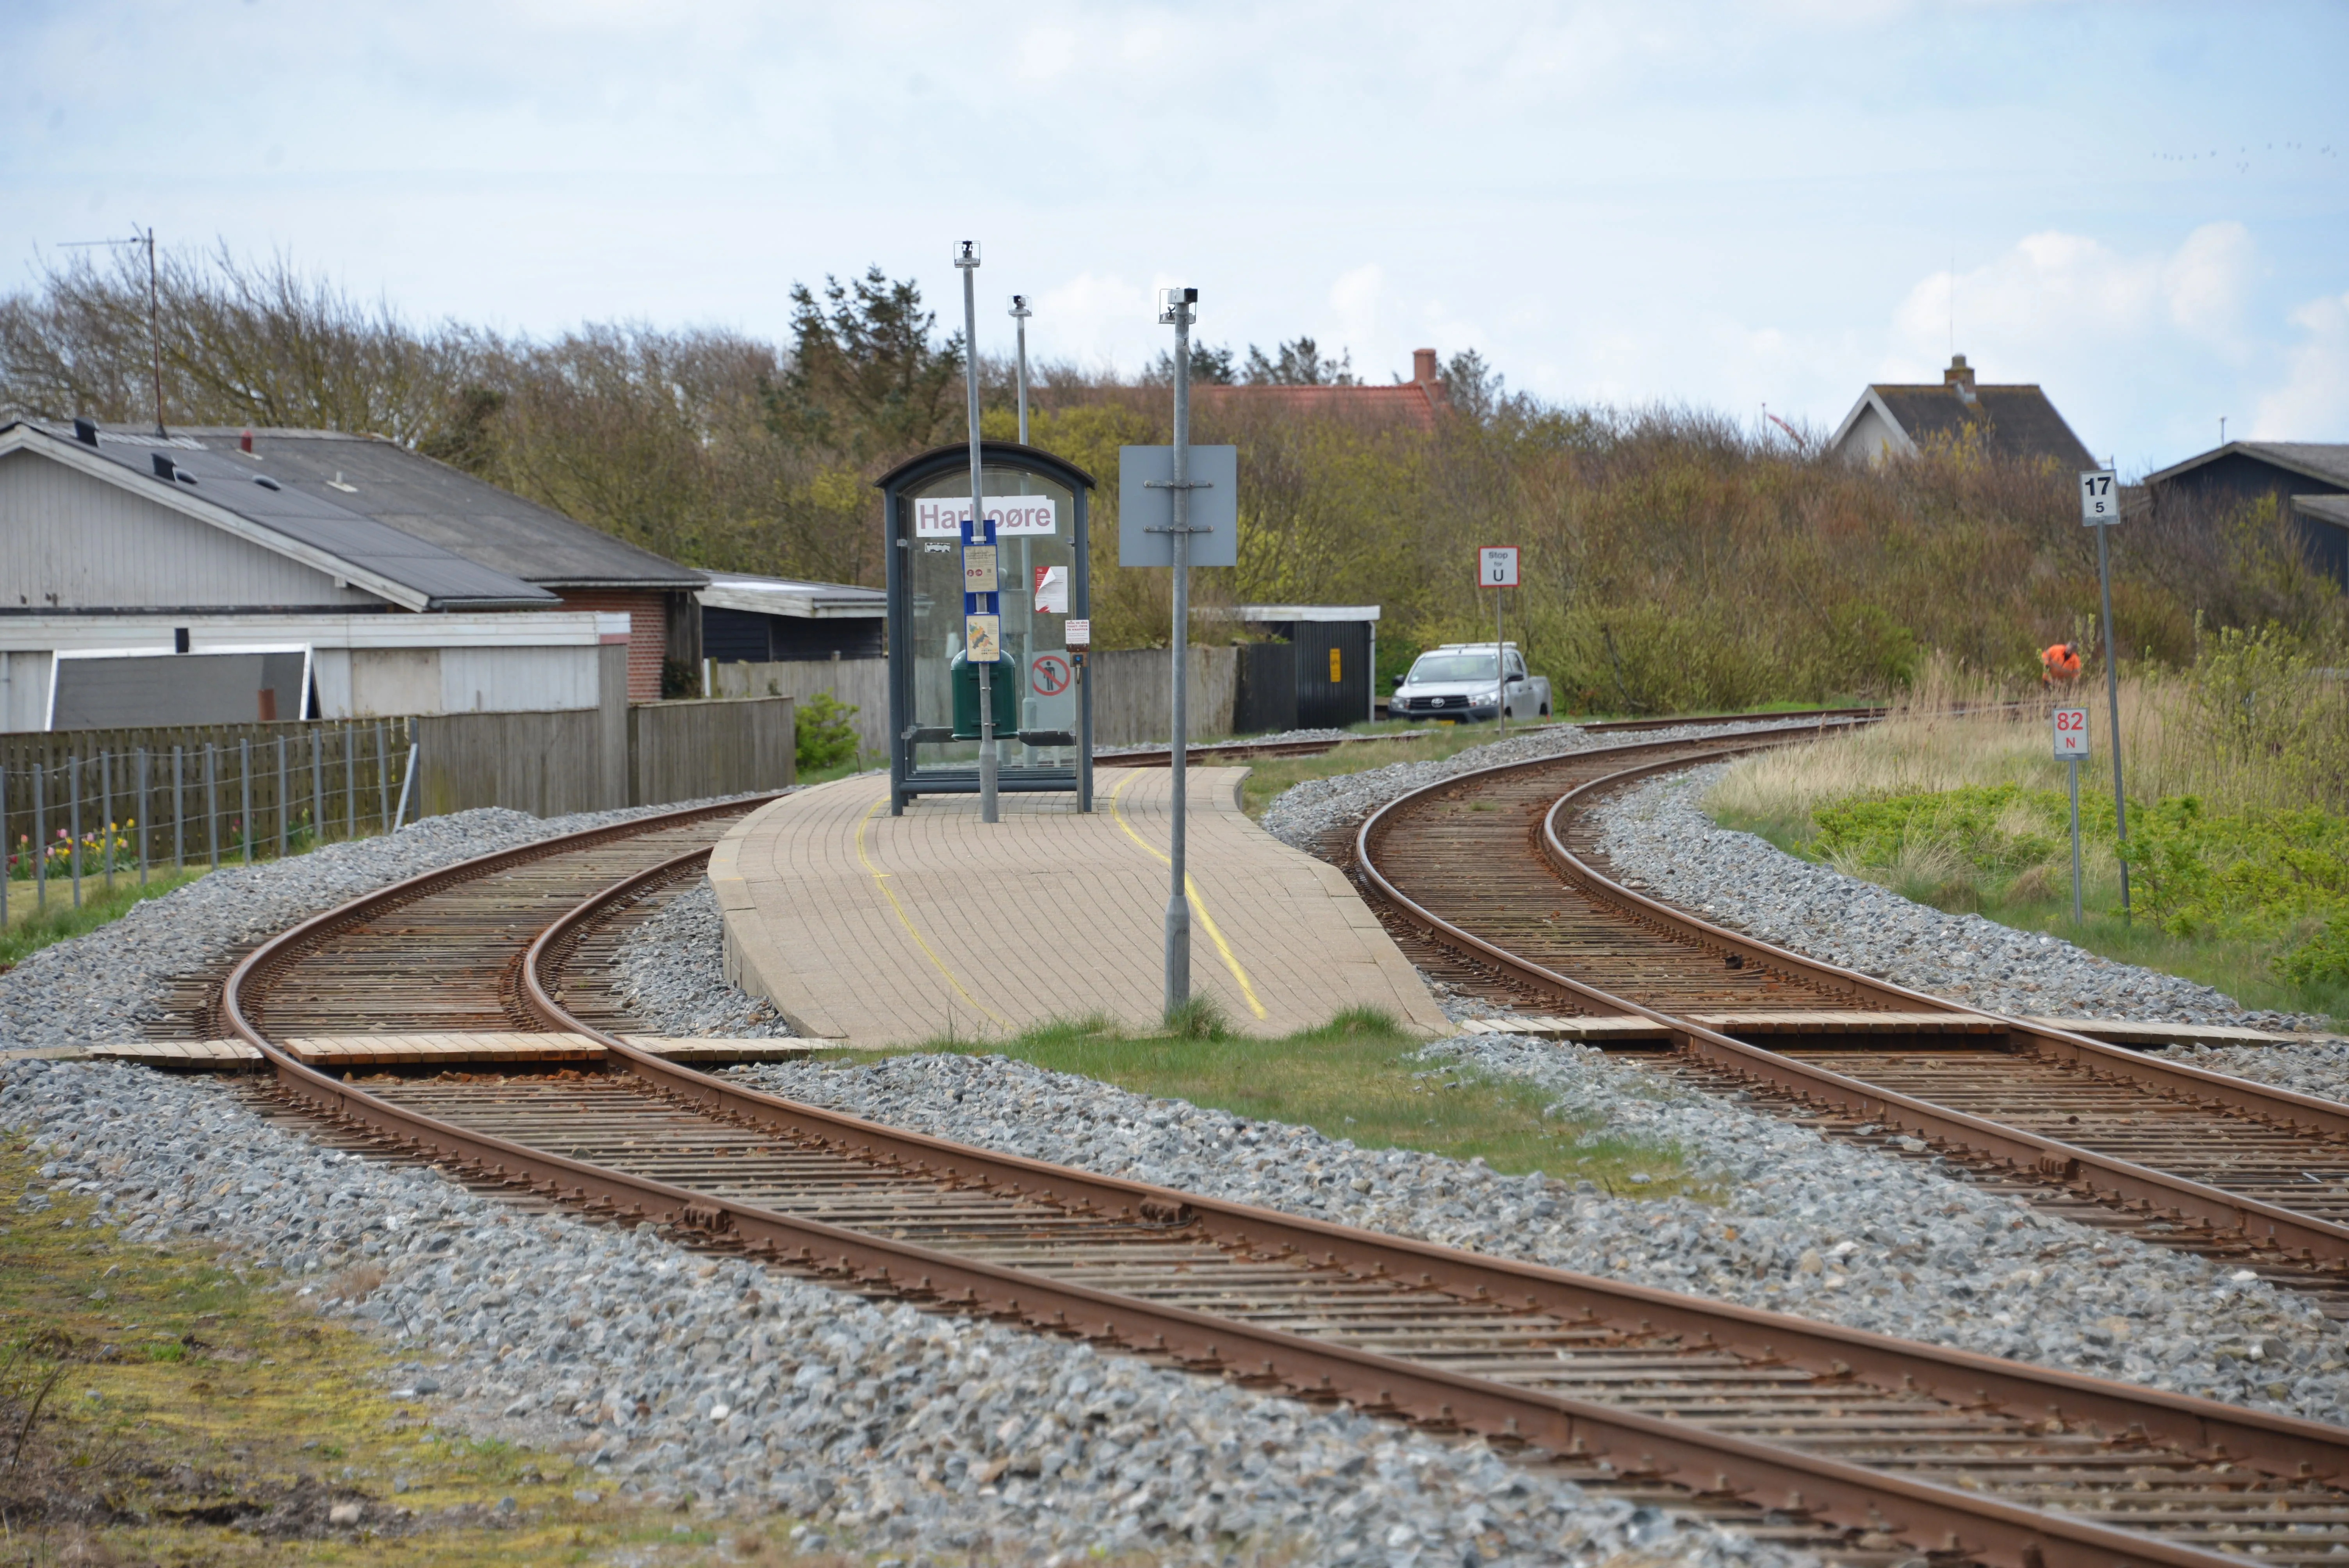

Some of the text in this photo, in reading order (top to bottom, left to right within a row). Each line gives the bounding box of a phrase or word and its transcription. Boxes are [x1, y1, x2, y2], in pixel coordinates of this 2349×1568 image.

[2085, 476, 2111, 496] 17
[2096, 502, 2105, 513] 5
[1488, 551, 1508, 560] Stop
[1494, 569, 1503, 582] U
[2057, 712, 2083, 731] 82
[2066, 737, 2075, 748] N
